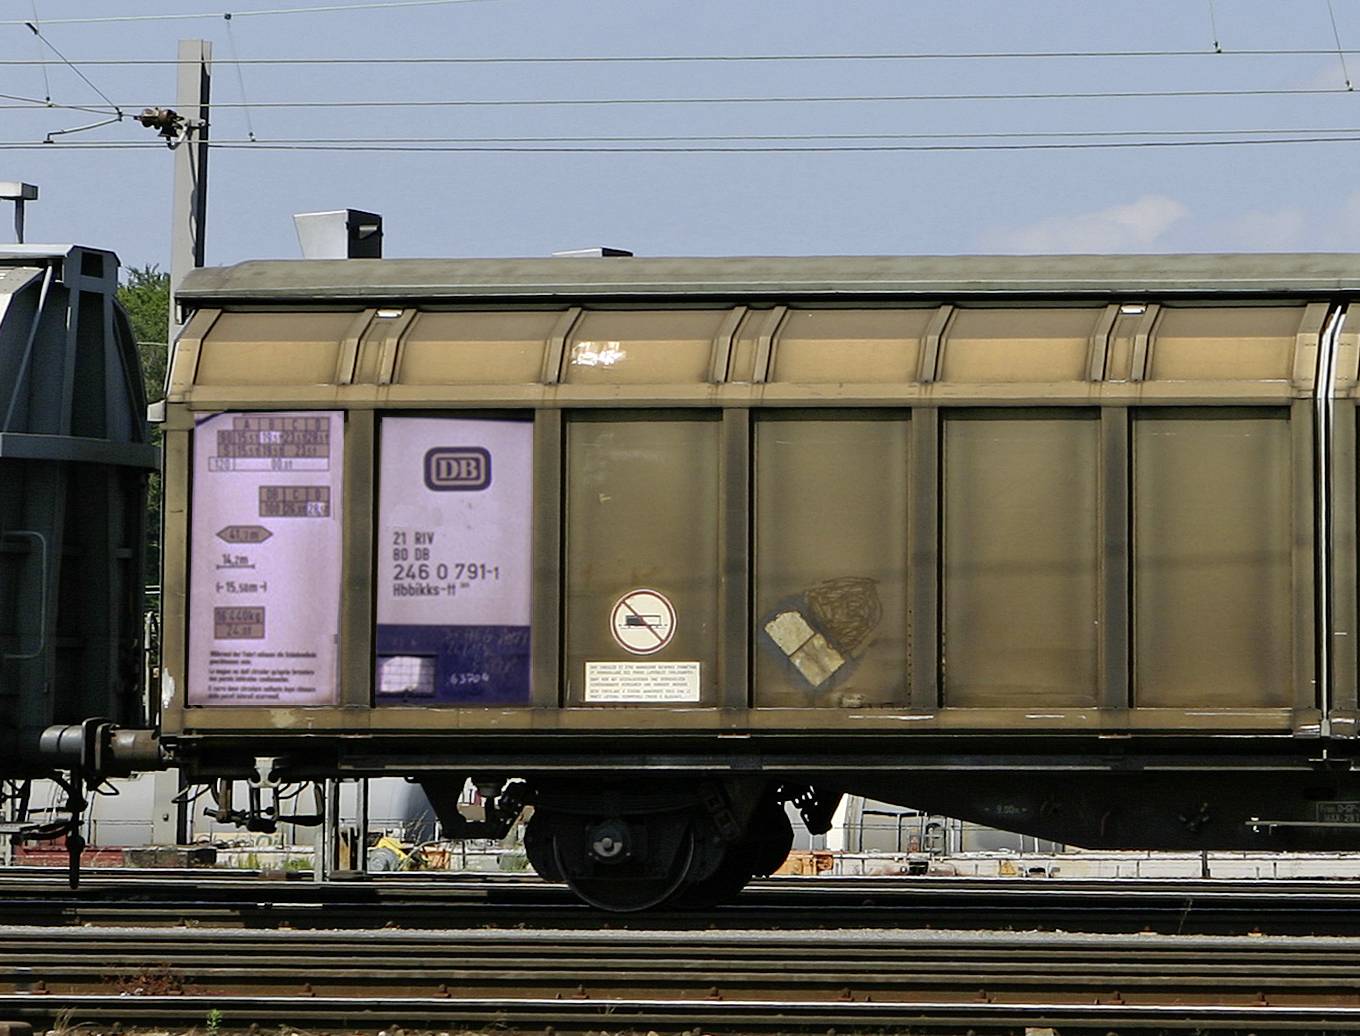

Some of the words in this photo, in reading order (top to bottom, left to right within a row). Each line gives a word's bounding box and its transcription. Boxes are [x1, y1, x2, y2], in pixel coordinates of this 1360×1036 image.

[438, 459, 479, 479] DB
[393, 532, 407, 545] 21
[414, 532, 435, 545] RIV
[414, 548, 430, 561] DB
[393, 563, 430, 580] 246
[436, 563, 449, 580] 0
[454, 563, 500, 580] 791-1
